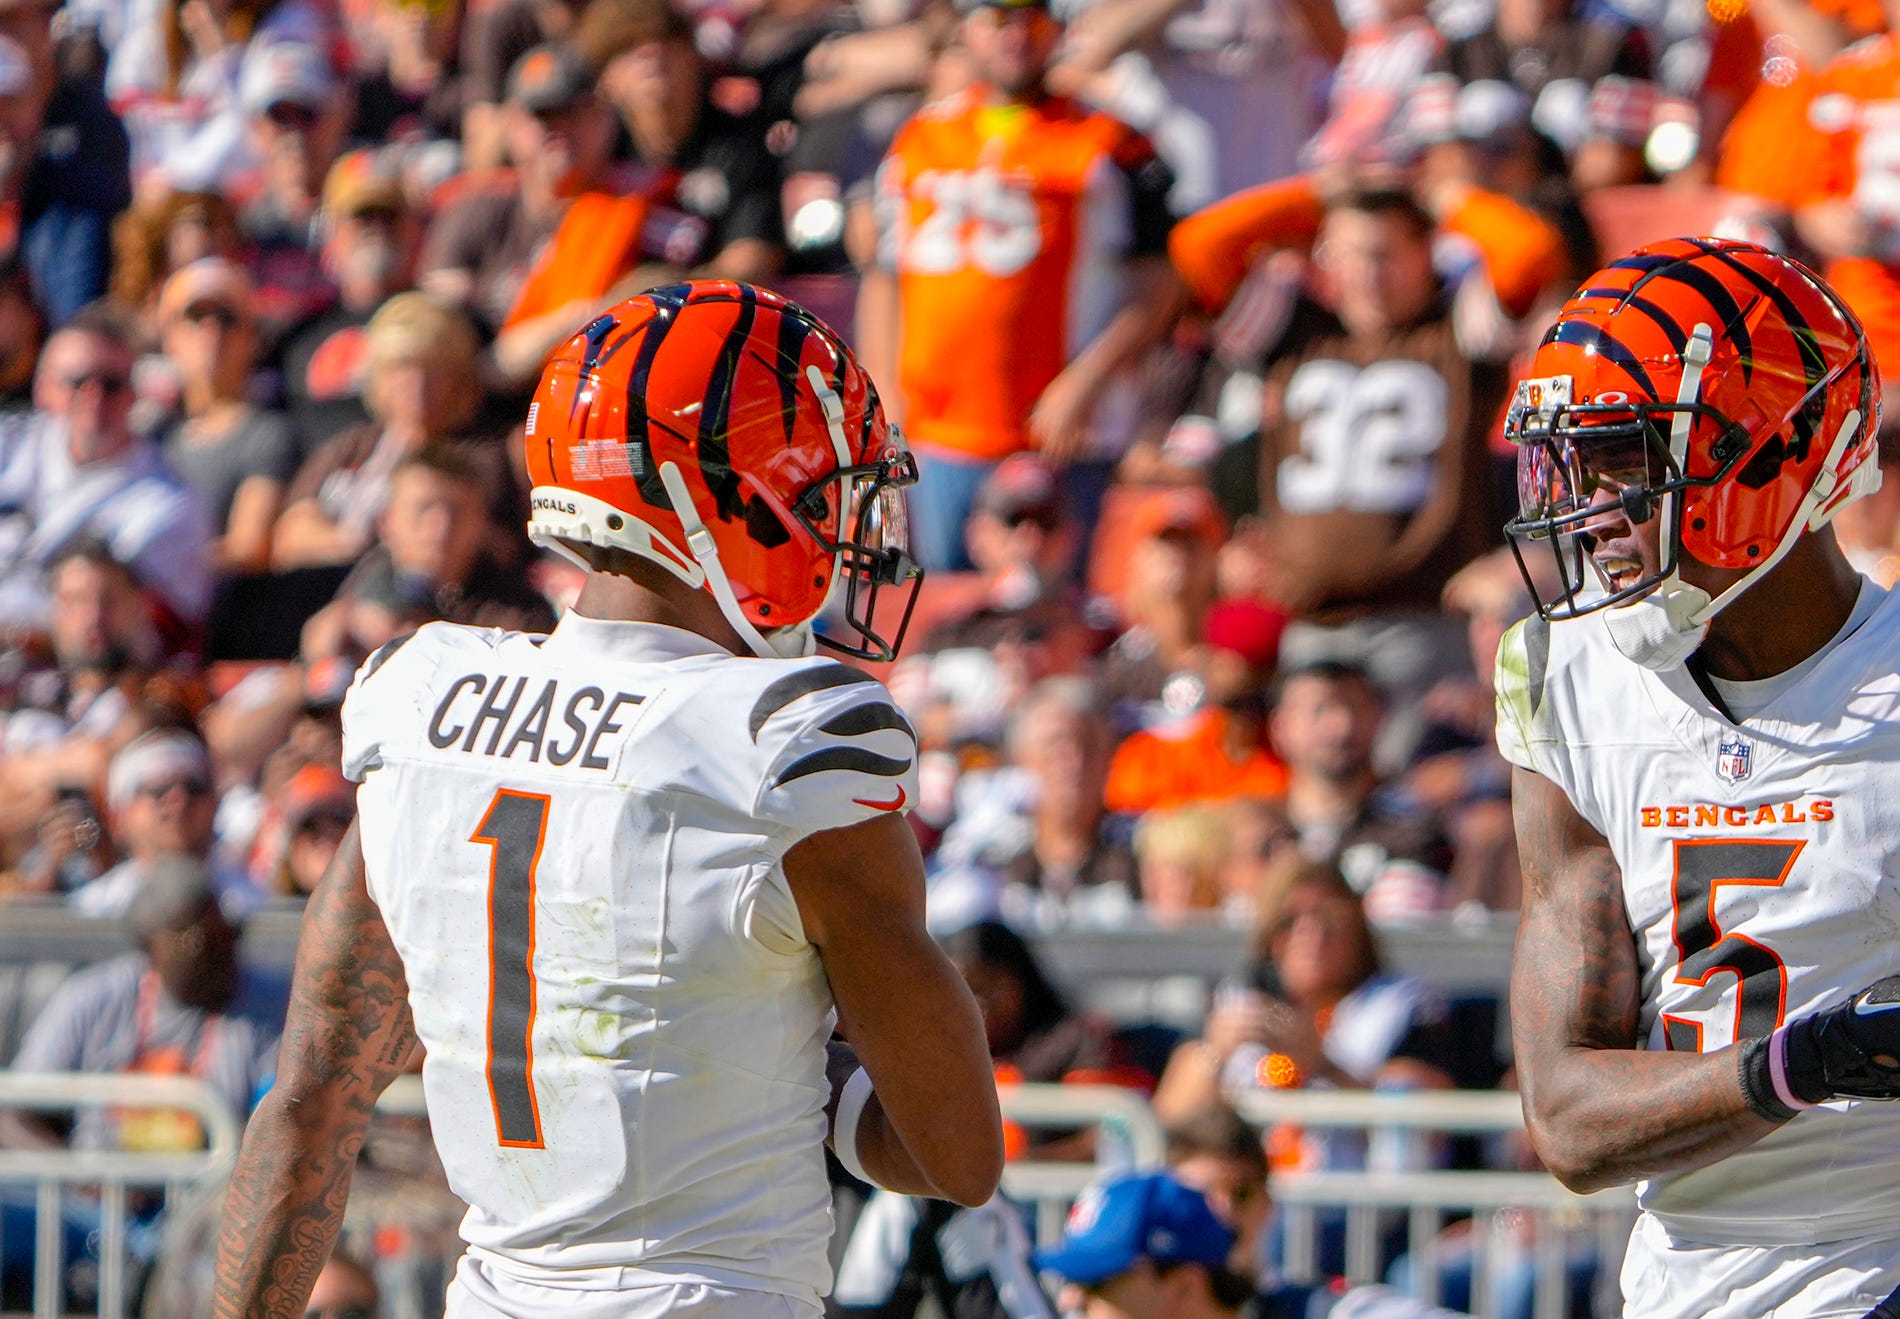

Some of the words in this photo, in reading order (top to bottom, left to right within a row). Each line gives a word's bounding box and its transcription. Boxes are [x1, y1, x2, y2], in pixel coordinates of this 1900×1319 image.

[1277, 358, 1449, 515] 32
[532, 498, 576, 514] ENGALS
[429, 673, 646, 770] CHASE
[1641, 800, 1834, 828] BENGALS
[469, 787, 552, 1150] 1
[1663, 837, 1808, 1054] 5
